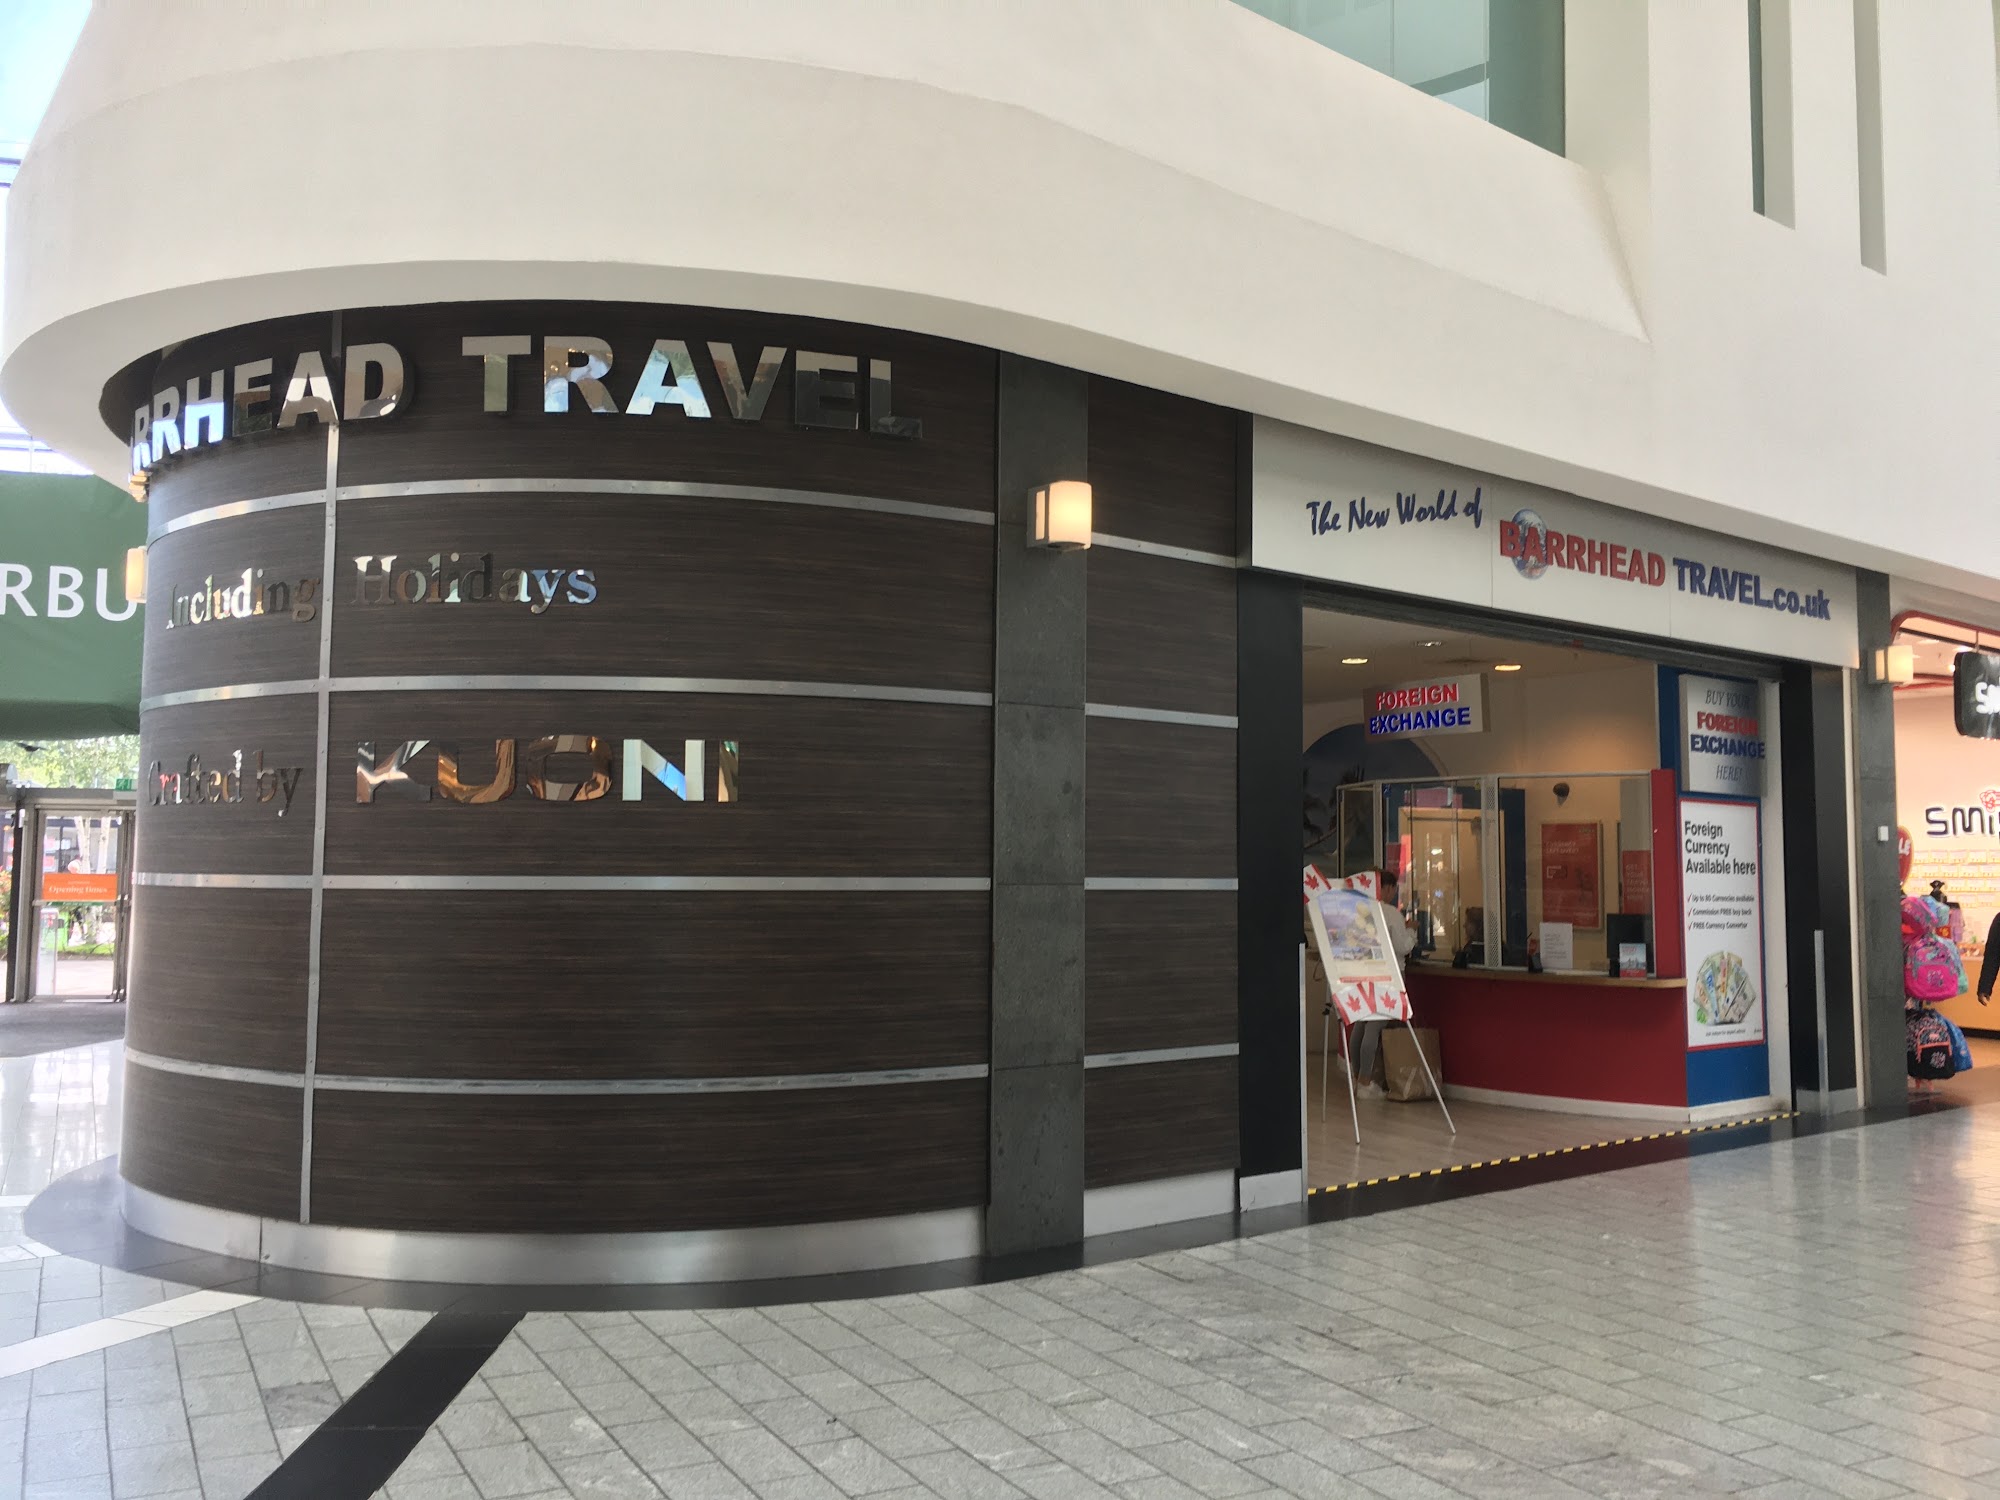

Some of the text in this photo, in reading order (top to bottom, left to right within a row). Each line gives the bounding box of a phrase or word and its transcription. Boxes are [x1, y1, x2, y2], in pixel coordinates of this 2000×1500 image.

[130, 335, 923, 475] RRHEAD TRAVEL
[1306, 487, 1483, 536] The New World of
[1500, 519, 1831, 621] BARRHEAD TRAVEL.co.uk
[166, 552, 597, 629] Including Holidays
[1376, 683, 1459, 711] FOREIGN
[1705, 689, 1752, 709] BUY YOUR
[1370, 707, 1471, 735] EXCHANGE
[1697, 711, 1759, 736] FOREIGN
[1690, 734, 1766, 759] EXCHANGE
[356, 735, 740, 804] KUONI
[1716, 765, 1743, 781] HERE!
[149, 749, 303, 817] Crafted by
[1685, 821, 1723, 840] Foreign
[1685, 839, 1730, 857] Currency
[1686, 857, 1756, 875] Available here
[49, 886, 84, 894] Opening
